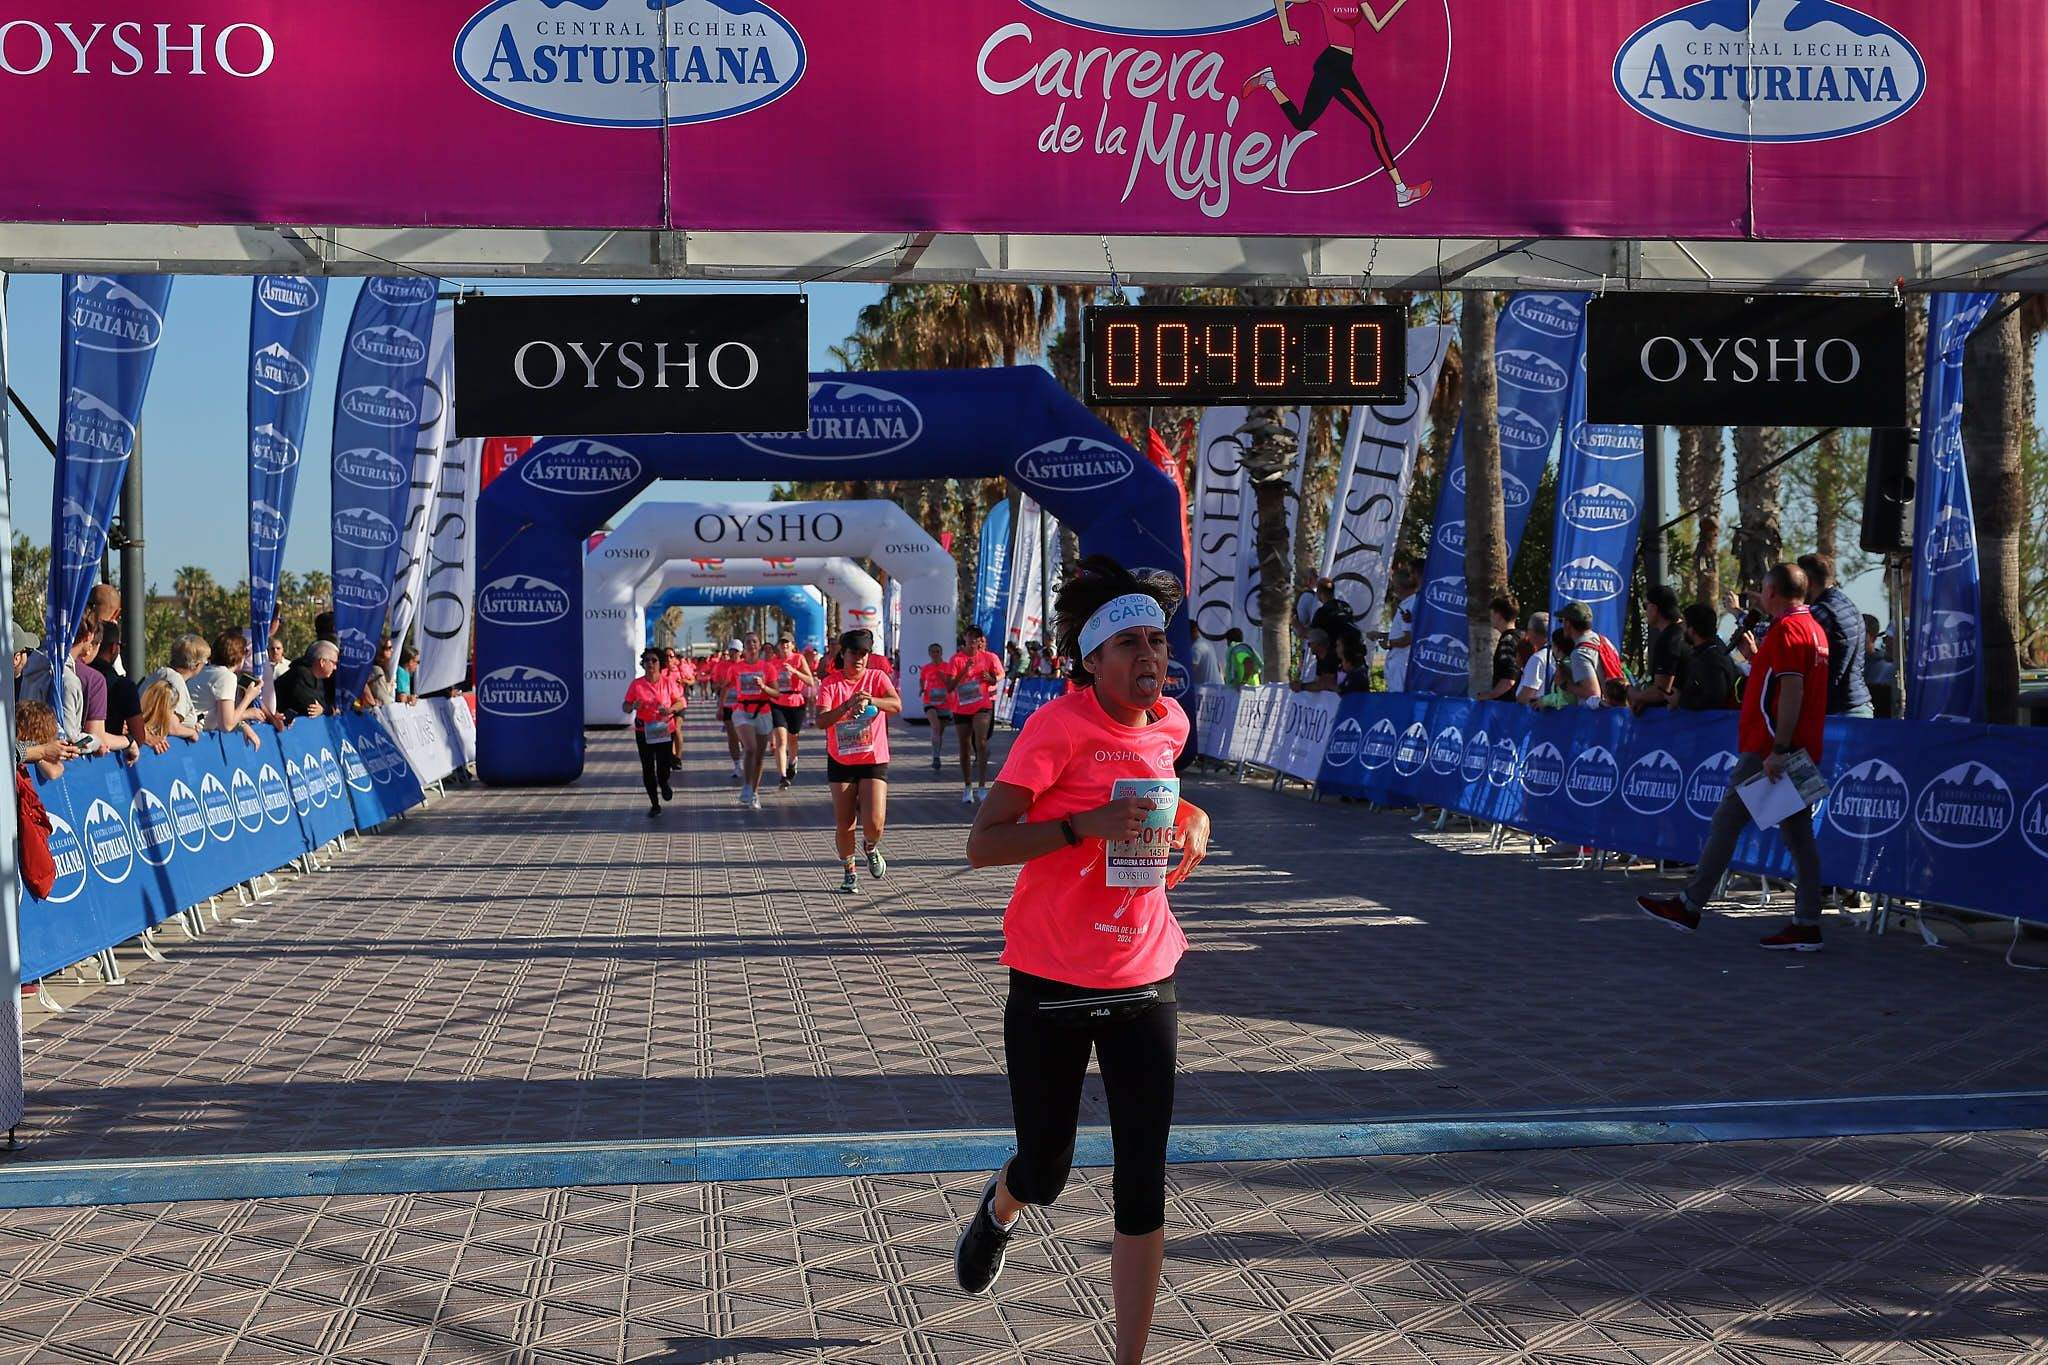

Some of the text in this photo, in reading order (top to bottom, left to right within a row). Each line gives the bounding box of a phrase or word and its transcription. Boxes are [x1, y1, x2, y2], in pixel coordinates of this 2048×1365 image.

[537, 21, 768, 38] CENTRAL ECHERA
[0, 20, 275, 78] OYSHO
[482, 24, 780, 85] ASTURIANA
[1686, 41, 1891, 58] CENTRAL LECHERA
[976, 22, 1225, 101] Carrera
[1638, 43, 1903, 103] ASTURIANA
[1038, 96, 1318, 219] de la Mujer
[73, 306, 151, 344] URIANA
[513, 340, 760, 390] OYSHO
[1106, 323, 1382, 387] 00:40:10
[1640, 335, 1861, 384] OYSHO
[842, 404, 902, 413] LECHERA
[746, 417, 910, 440] URIANA
[527, 459, 632, 481] ASTURIANA
[1025, 459, 1127, 479] ASTURIANA
[694, 512, 843, 544] OYSHO
[1196, 434, 1245, 642] OYSHO
[604, 549, 650, 559] OYSHO
[885, 543, 931, 554] OYSHO
[482, 594, 564, 614] ASTURIANA
[585, 608, 628, 620] OYSHO
[909, 604, 950, 615] OYSHO
[1108, 604, 1158, 622] CAFO
[584, 670, 627, 680] OYSHO
[481, 684, 563, 704] ASTURIANA
[1624, 771, 1677, 800] ASTURIANA
[1831, 786, 1900, 820] ASTURIANA
[1920, 791, 2004, 830] ASTURIANA
[90, 832, 132, 867] ASTURIANA
[1149, 848, 1166, 857] 1451
[1112, 858, 1139, 867] CARRERA
[1140, 858, 1147, 867] DE
[1147, 859, 1155, 867] LA
[1118, 871, 1151, 880] OYSHO
[1117, 934, 1132, 943] 2024
